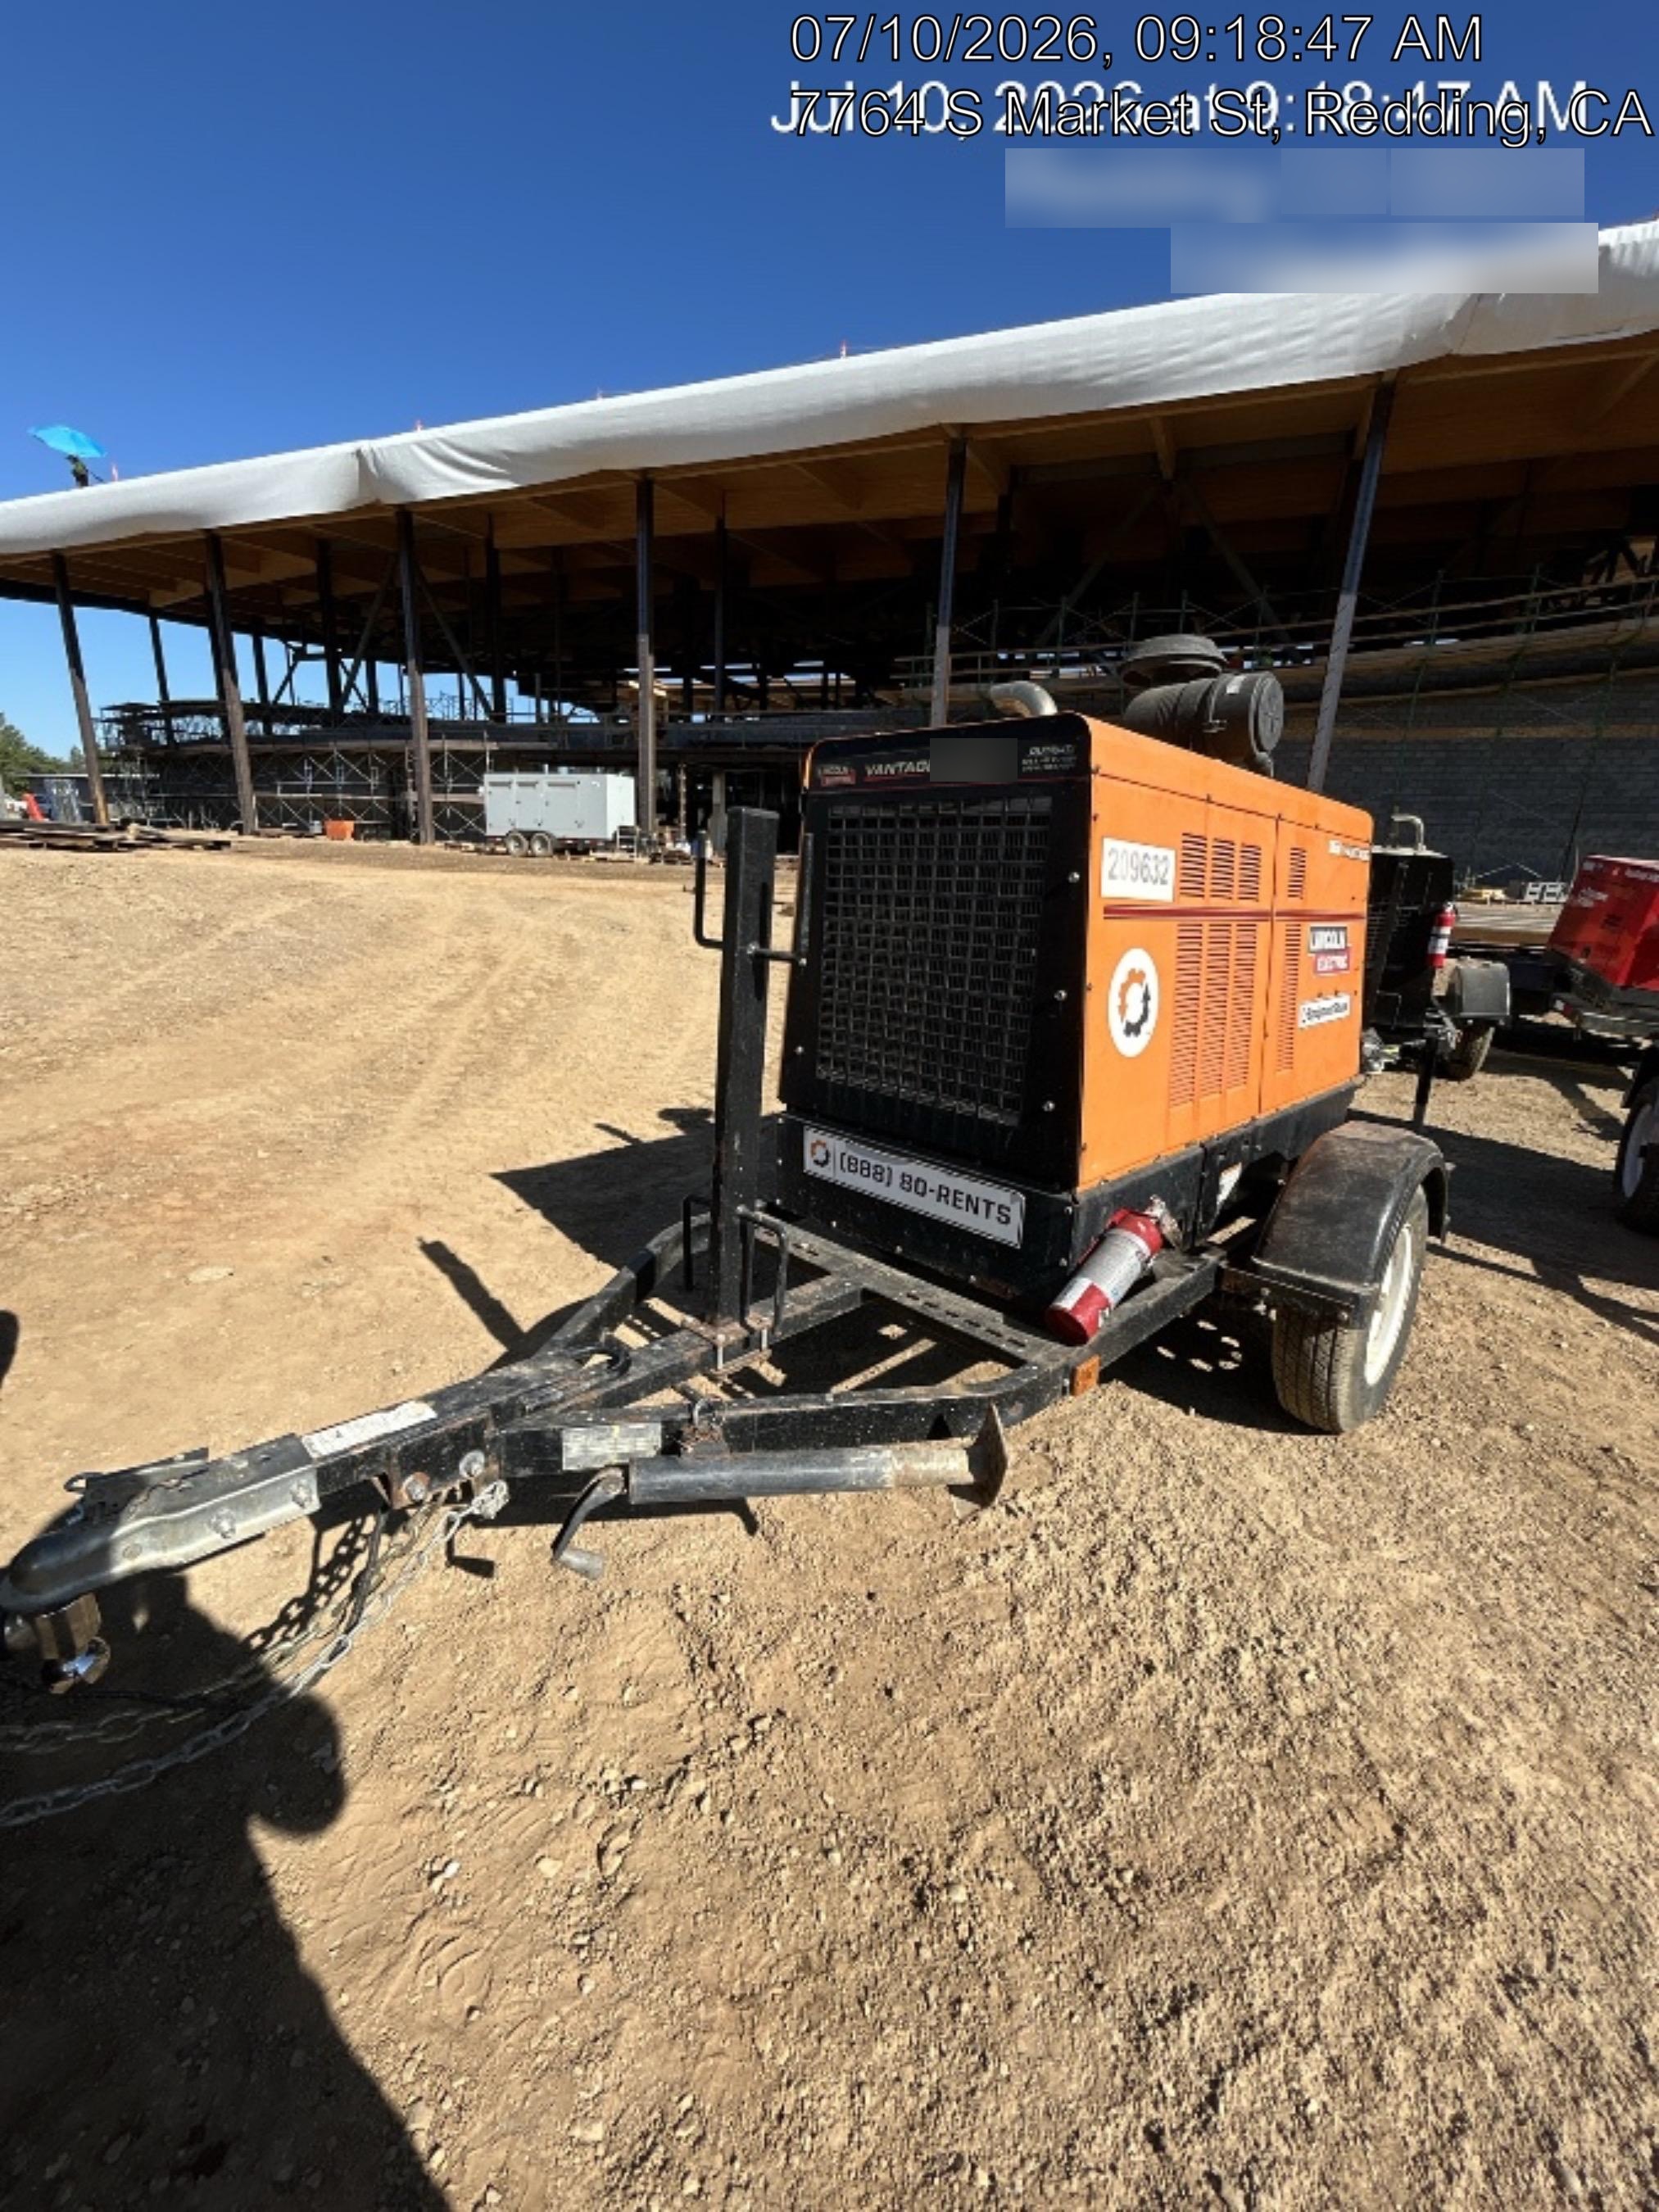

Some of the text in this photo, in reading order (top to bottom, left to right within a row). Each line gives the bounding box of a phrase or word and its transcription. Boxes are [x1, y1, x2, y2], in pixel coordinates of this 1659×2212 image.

[865, 759, 930, 777] VANTAG
[1107, 847, 1171, 886] 209632
[840, 1152, 1012, 1226] (888) 80-RENTS
